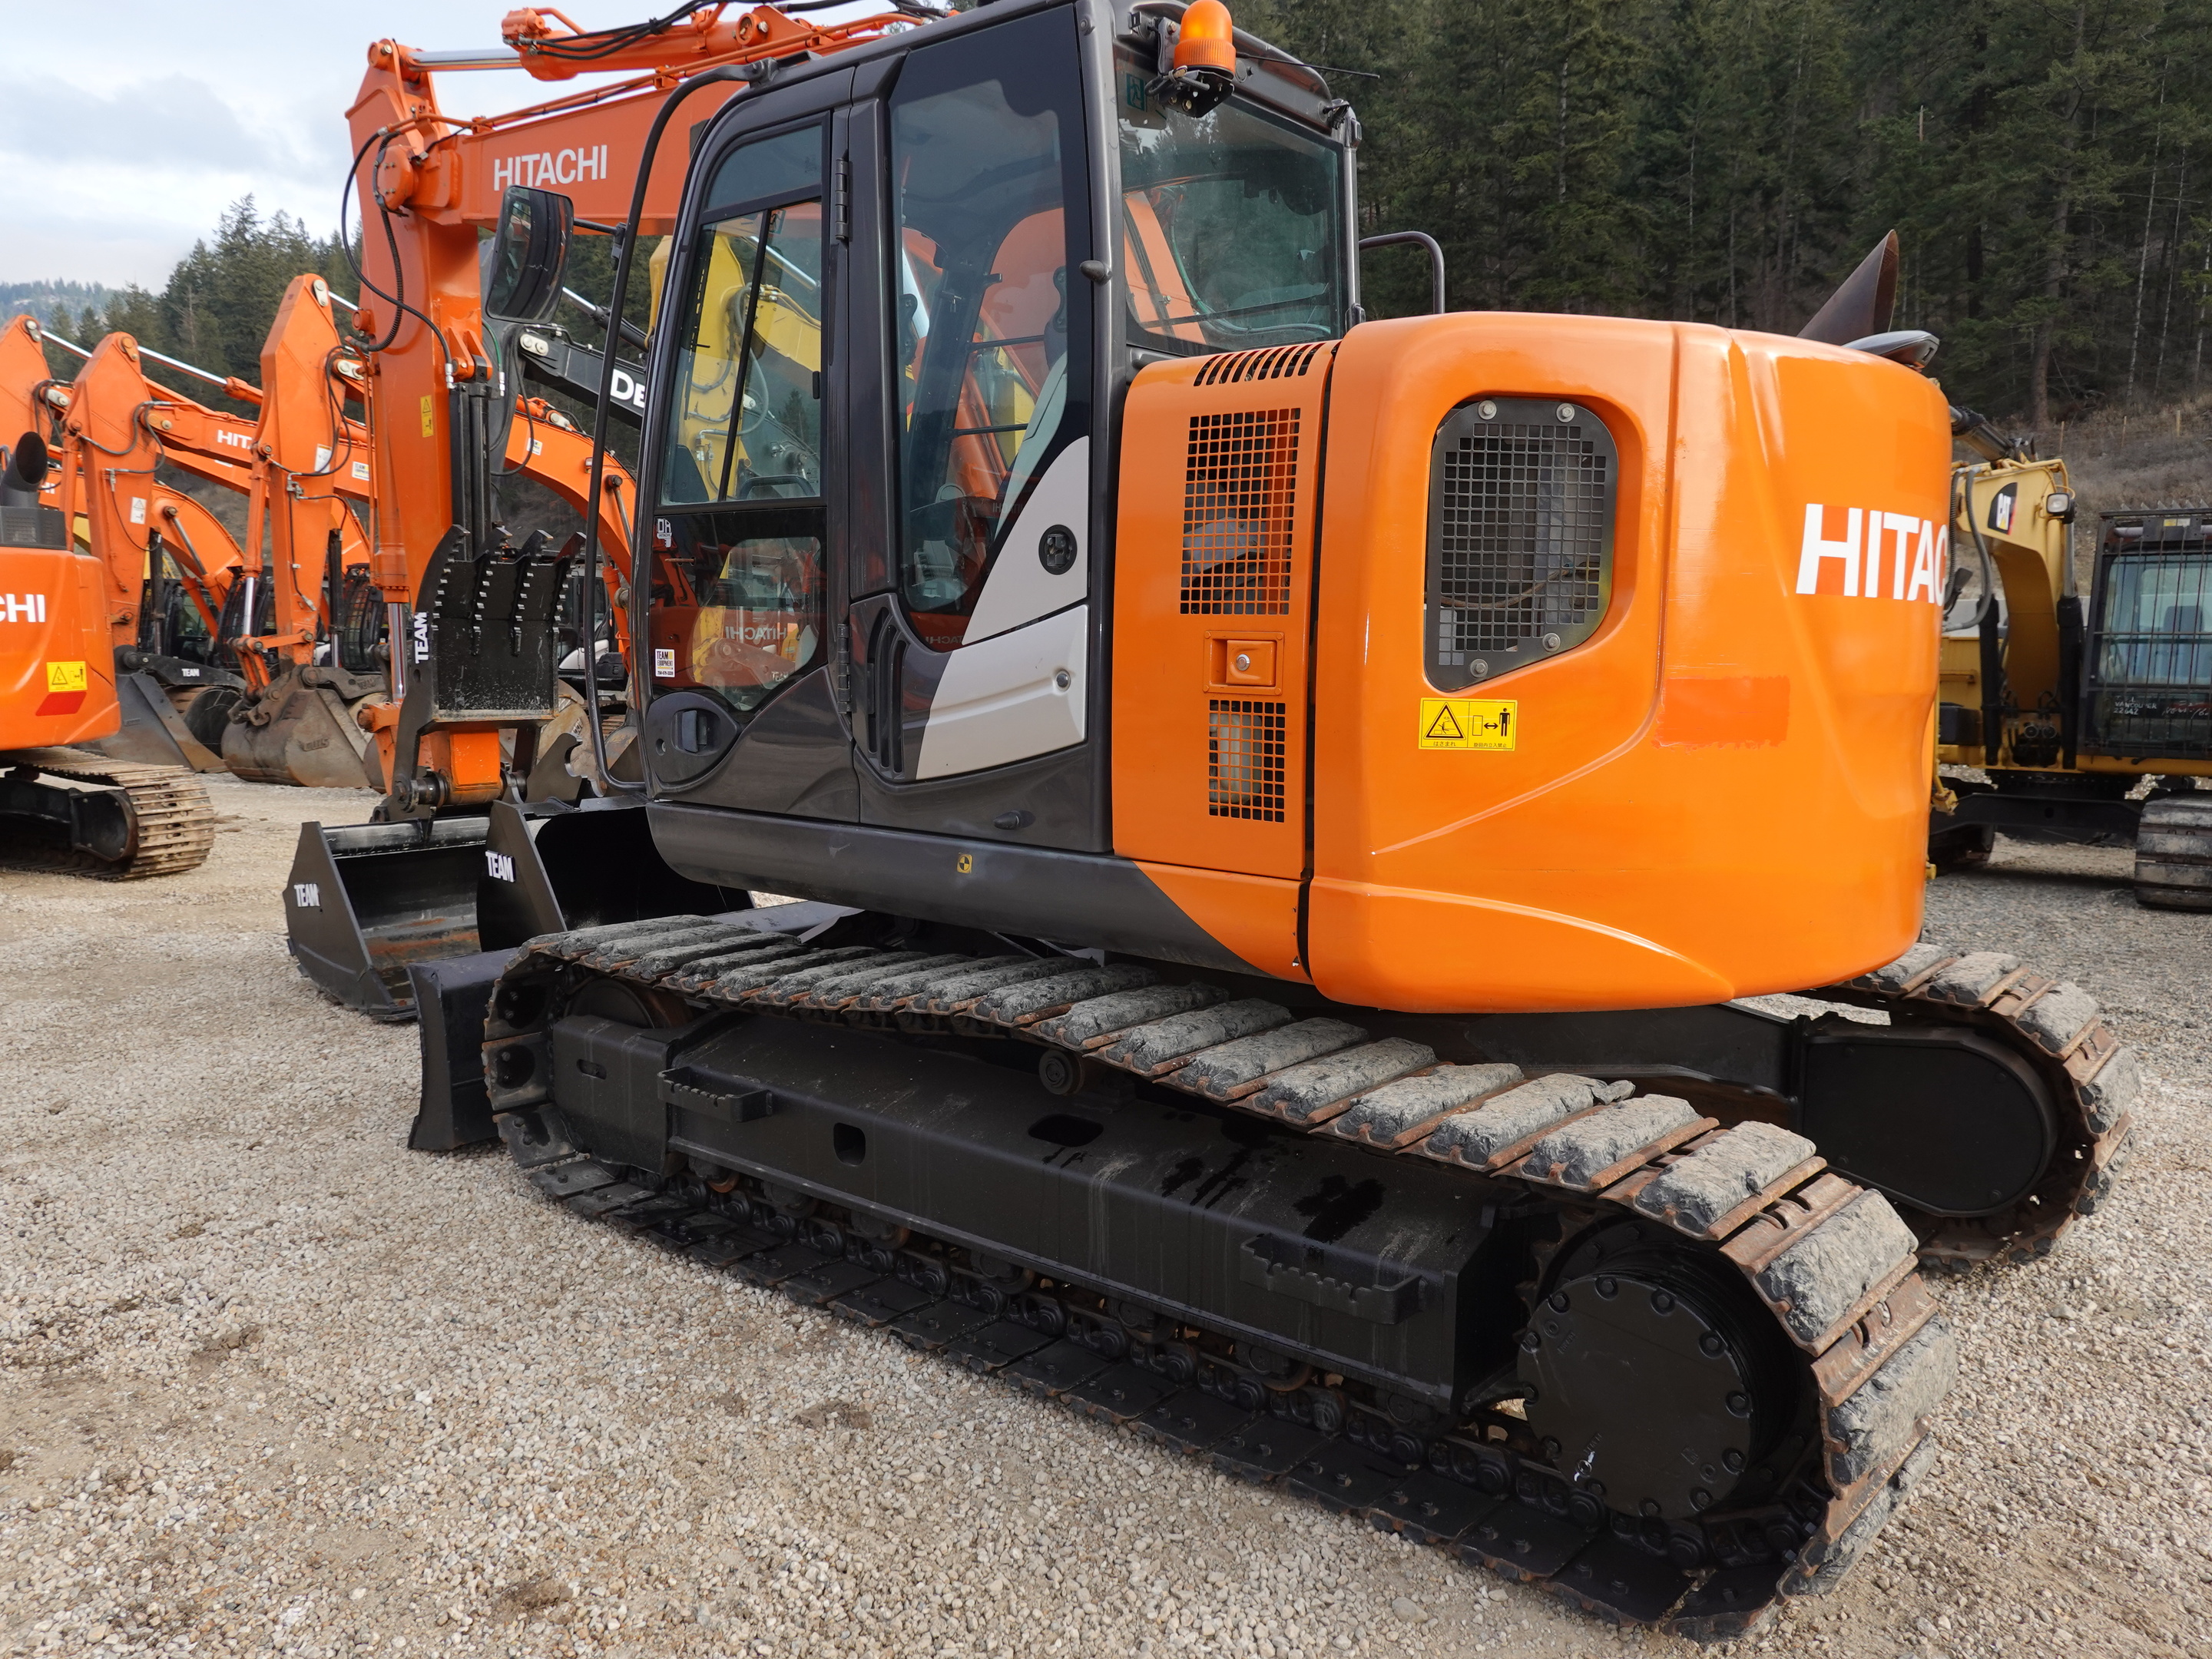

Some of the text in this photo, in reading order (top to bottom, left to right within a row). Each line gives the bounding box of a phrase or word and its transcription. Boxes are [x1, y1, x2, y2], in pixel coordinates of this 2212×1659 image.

[494, 144, 608, 191] HITACHI
[217, 429, 253, 450] HIT
[1996, 492, 2012, 531] CAT
[414, 611, 429, 664] TEAM
[657, 651, 669, 661] TEAM
[181, 668, 200, 677] TEAM
[2114, 700, 2157, 710] VANCOUER
[485, 849, 516, 883] TEAM
[293, 882, 321, 908] TEAM
